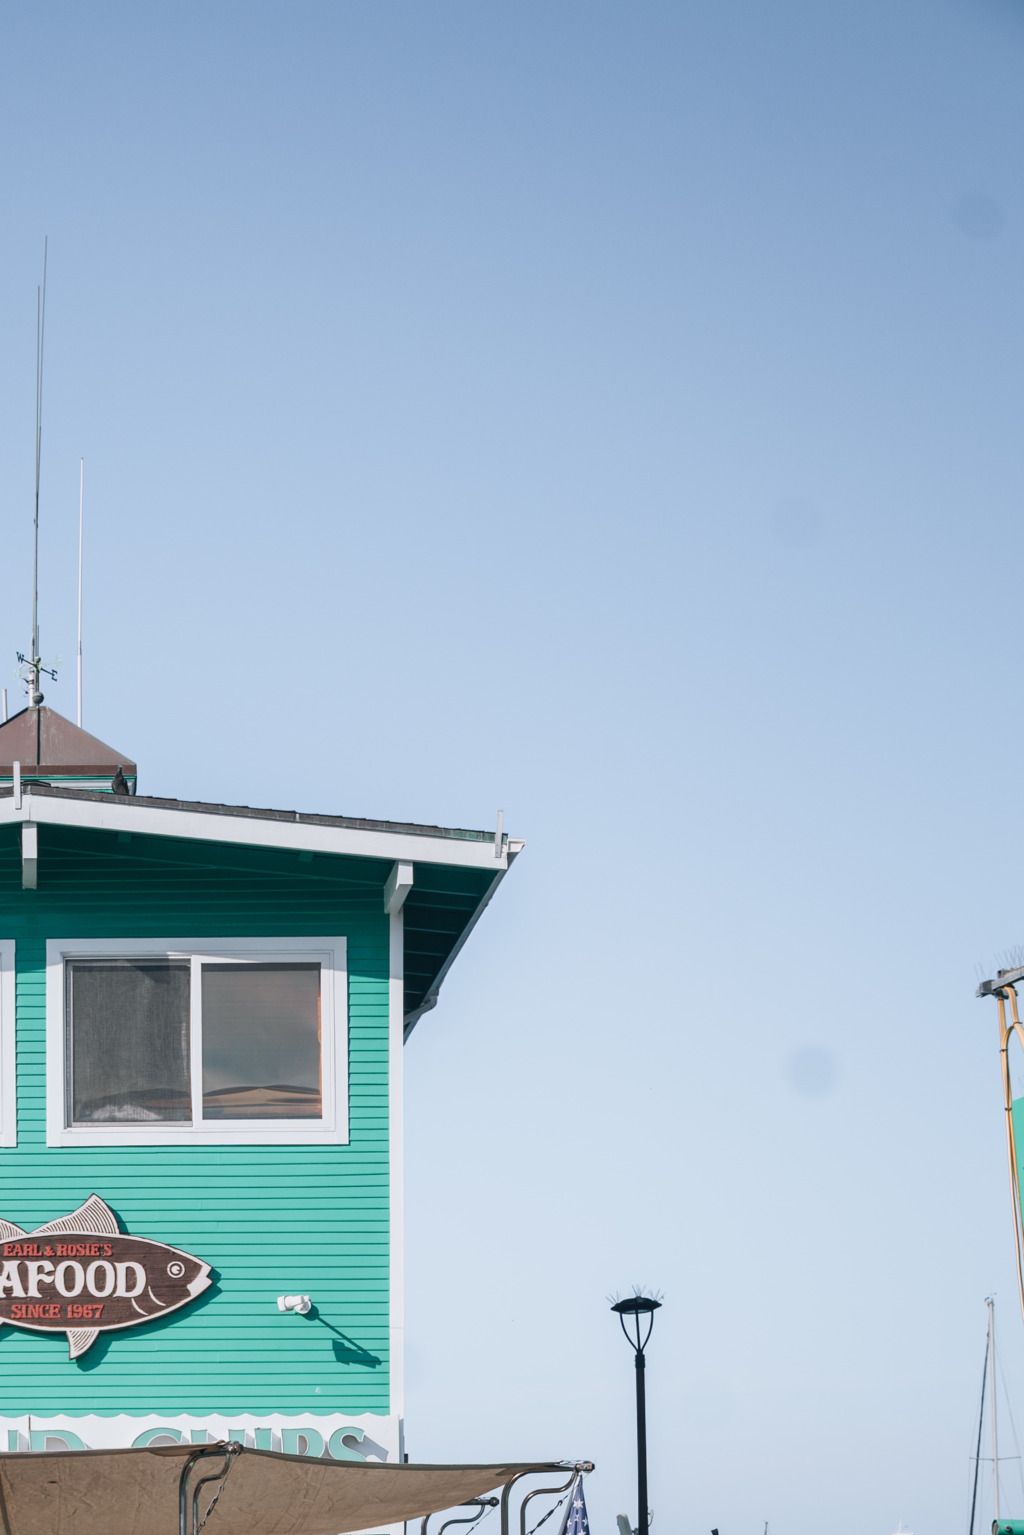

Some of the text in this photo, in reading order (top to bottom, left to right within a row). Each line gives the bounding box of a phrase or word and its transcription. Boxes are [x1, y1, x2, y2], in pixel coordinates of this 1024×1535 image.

[2, 1243, 113, 1257] EARL & ROSIE'S
[10, 1303, 105, 1319] SINCE 1967
